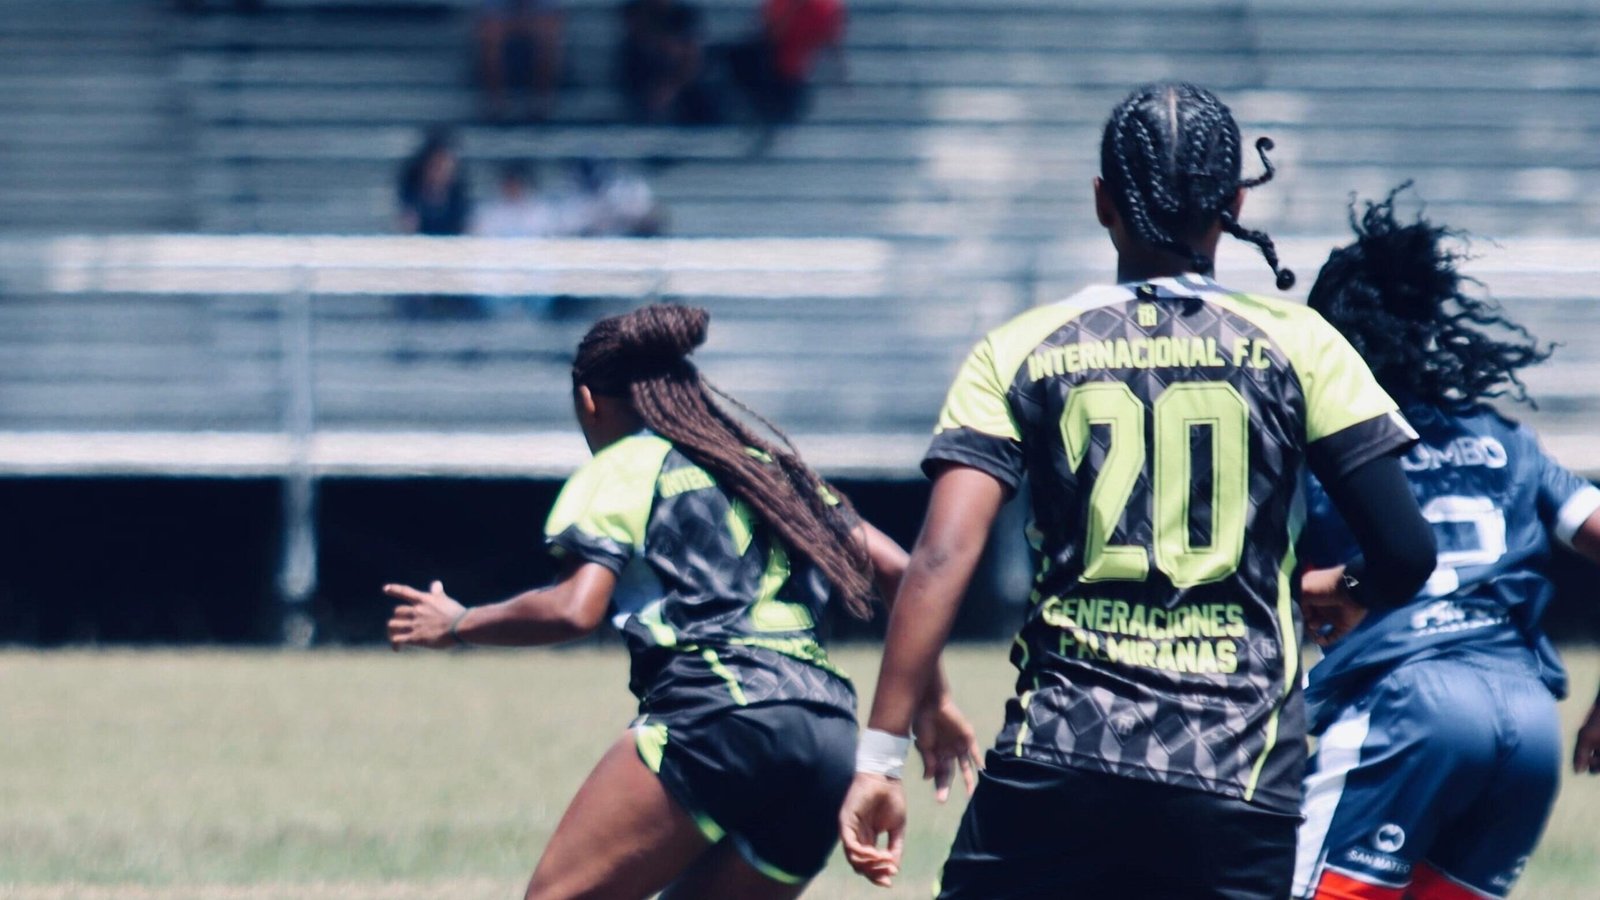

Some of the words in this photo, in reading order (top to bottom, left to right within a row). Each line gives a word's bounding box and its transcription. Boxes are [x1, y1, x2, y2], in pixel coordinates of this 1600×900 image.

[1028, 336, 1225, 382] INTERNACIONAL
[1401, 436, 1507, 471] UMBO
[1059, 381, 1249, 588] 20
[1042, 595, 1246, 640] GENERACIONES
[1349, 849, 1372, 865] SAN
